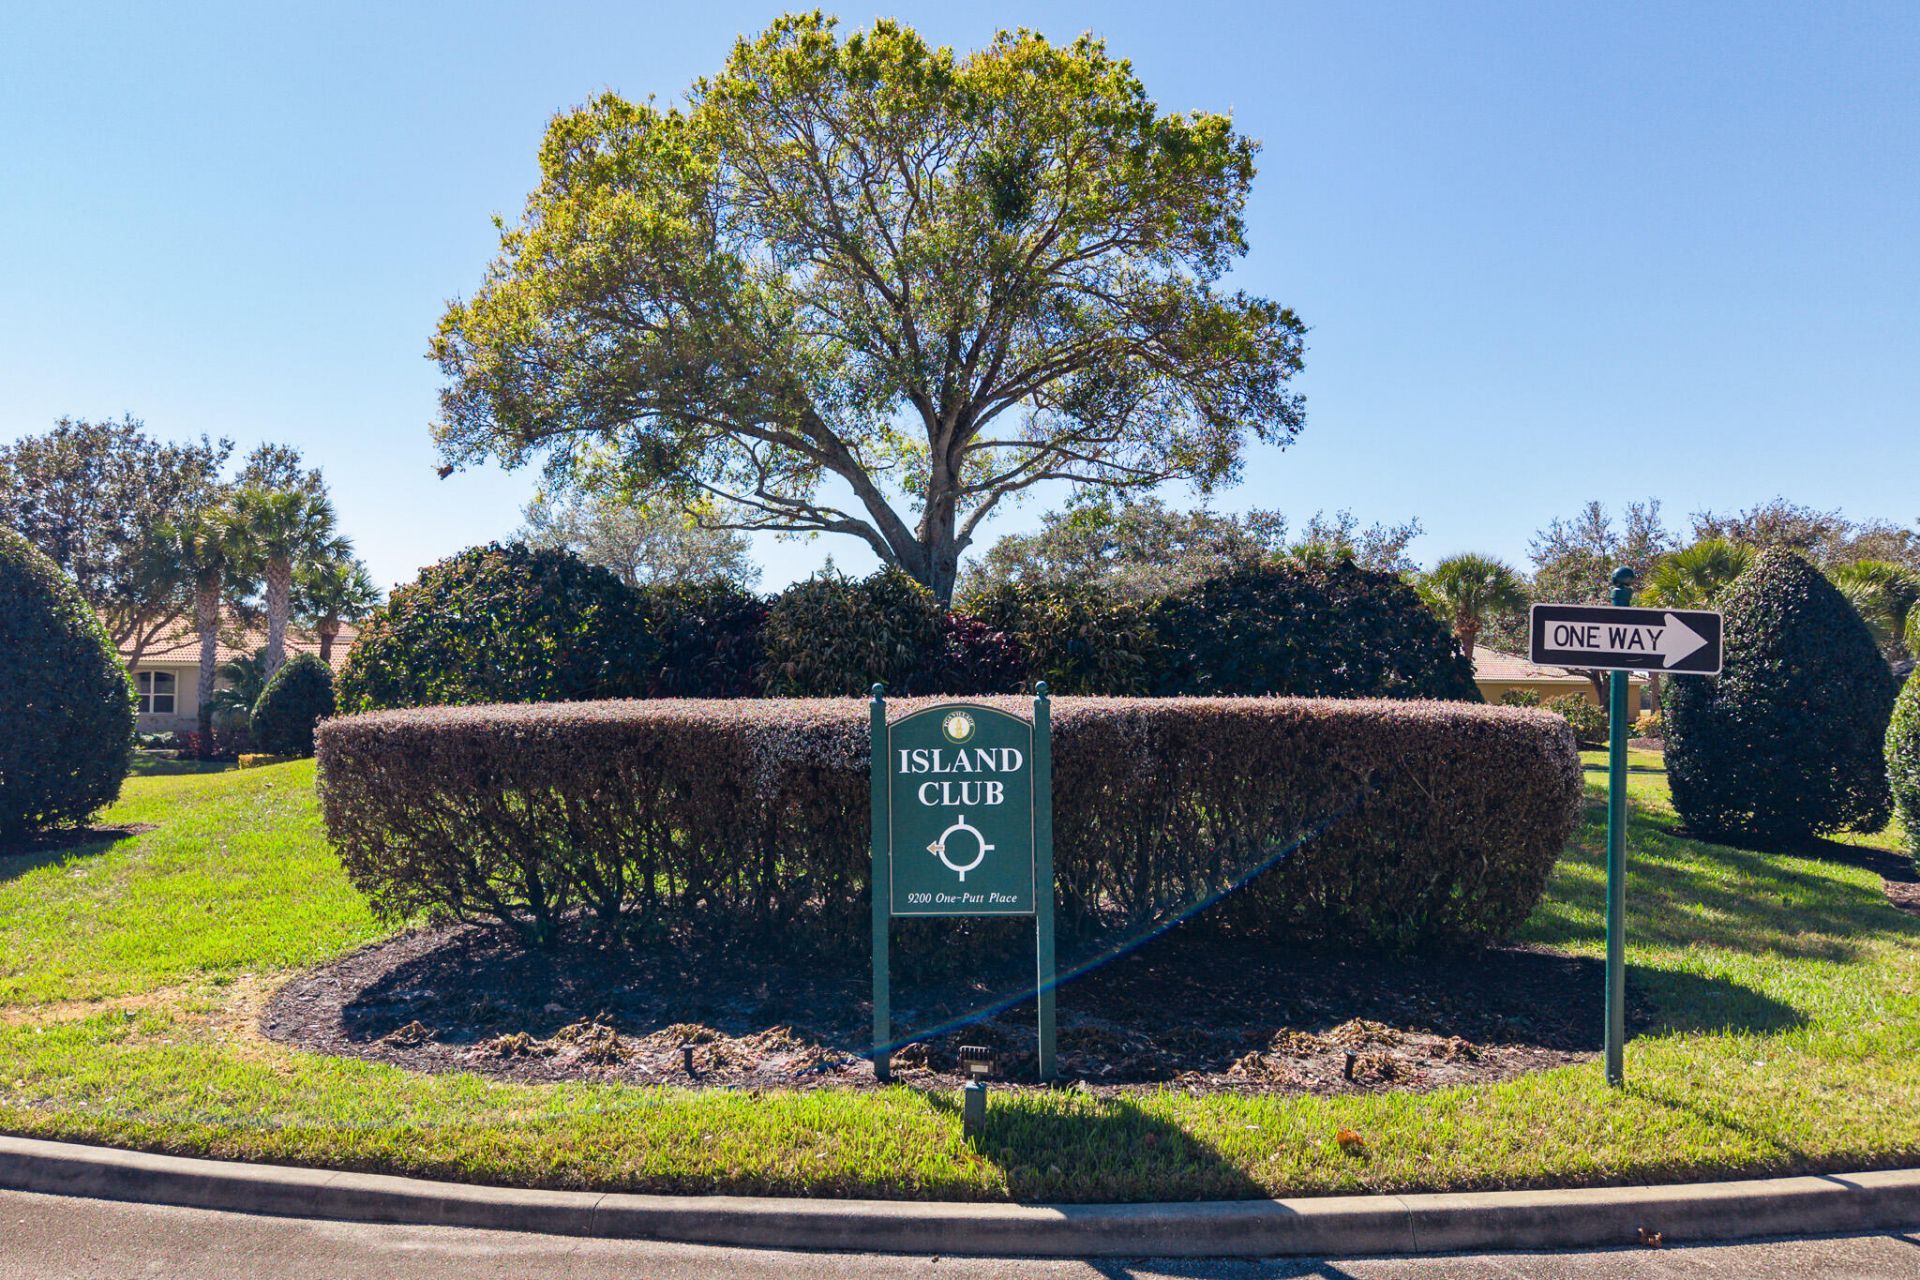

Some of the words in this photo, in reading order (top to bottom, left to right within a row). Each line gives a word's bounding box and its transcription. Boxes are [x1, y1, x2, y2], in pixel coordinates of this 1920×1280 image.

[1554, 624, 1600, 648] ONE
[1608, 627, 1664, 651] WAY
[898, 748, 1023, 773] ISLAND
[918, 781, 1004, 806] CLUB
[907, 892, 932, 904] 9200
[935, 892, 984, 904] One-Putt
[989, 892, 1018, 904] Place
